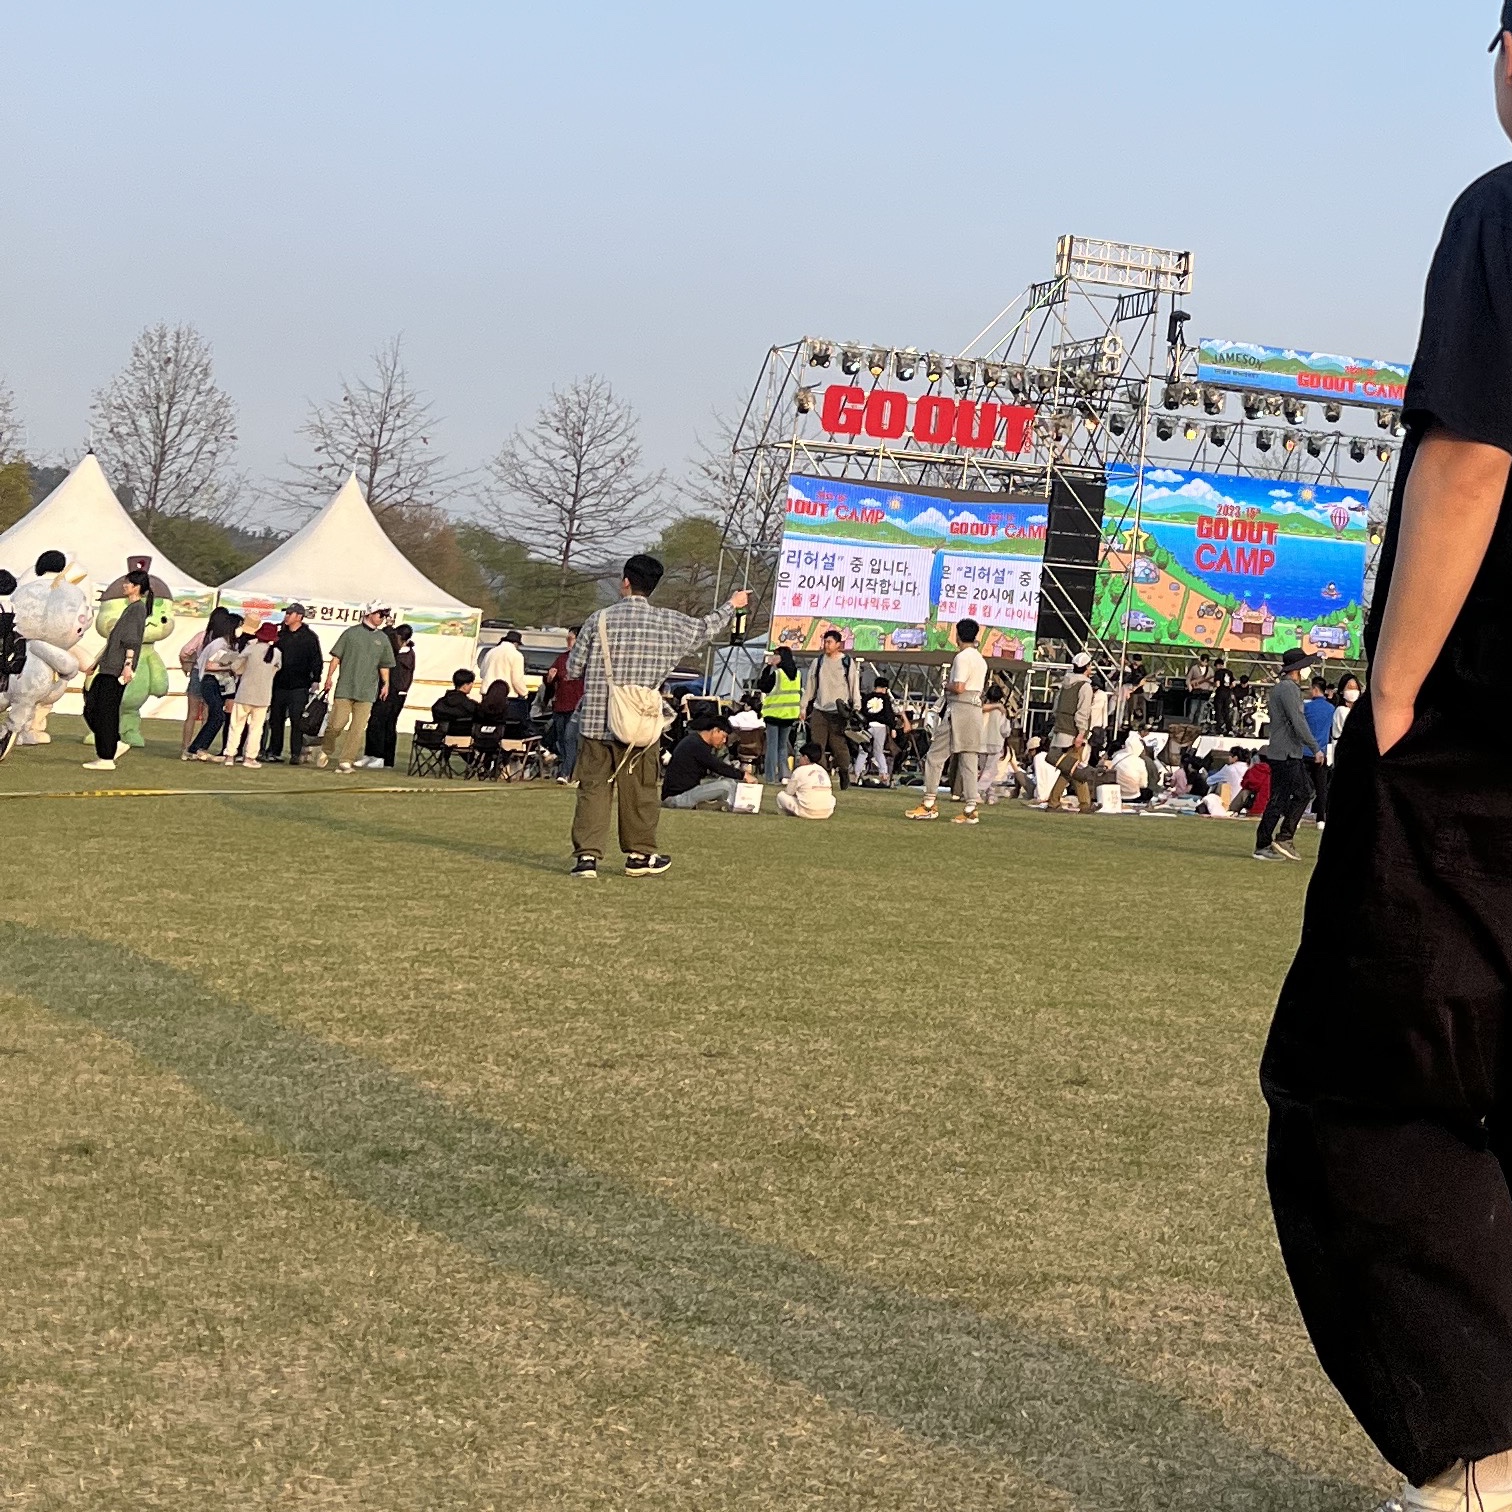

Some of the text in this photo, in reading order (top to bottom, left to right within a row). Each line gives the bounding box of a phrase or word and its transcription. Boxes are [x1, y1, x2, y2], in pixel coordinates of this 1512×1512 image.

[1213, 352, 1264, 370] JAMESON
[821, 384, 1035, 453] GO OUT
[835, 505, 885, 525] CAMP
[1197, 515, 1279, 546] GO OUT
[850, 556, 863, 574] 중
[869, 558, 912, 577] 입니다.
[1195, 543, 1275, 576] CAMP
[798, 574, 845, 593] 20시에
[850, 577, 920, 597] 시작합니다.
[1019, 570, 1032, 587] 중
[973, 587, 1015, 605] 20시에
